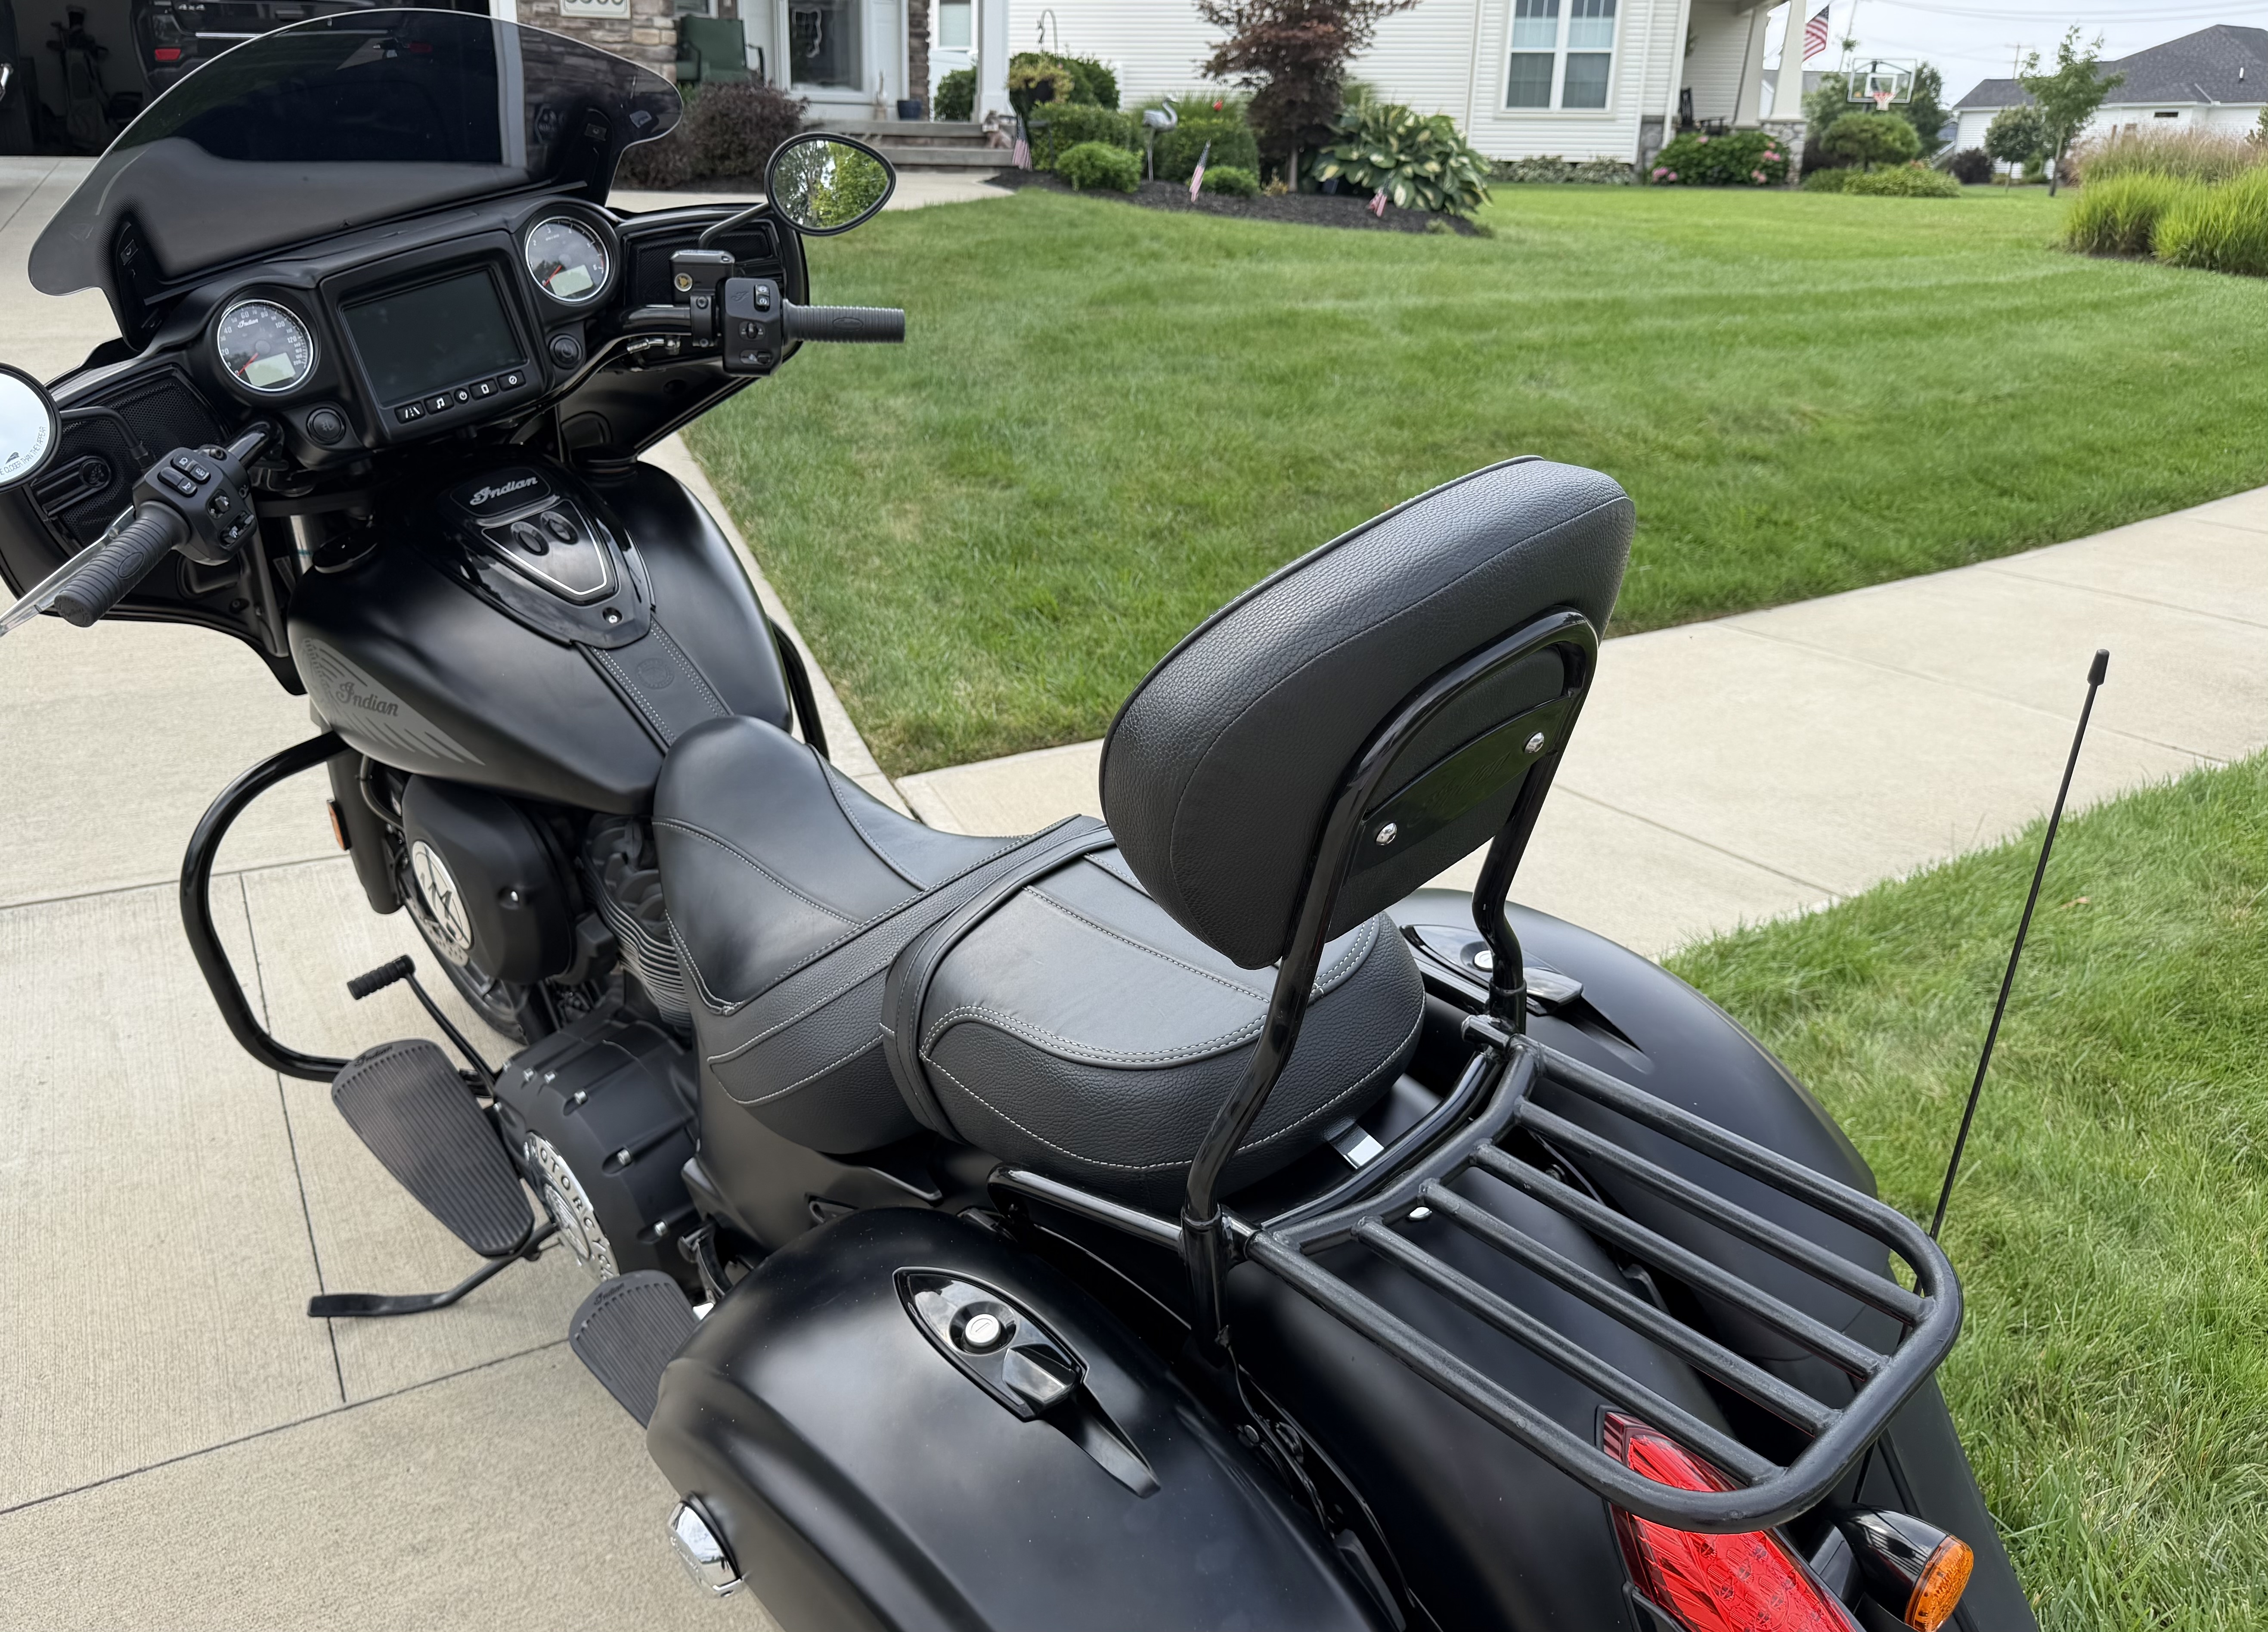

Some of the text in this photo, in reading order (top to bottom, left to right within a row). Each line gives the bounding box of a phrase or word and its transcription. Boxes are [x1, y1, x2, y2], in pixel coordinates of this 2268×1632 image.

[30, 443, 41, 458] THEY
[470, 477, 538, 506] Indian
[336, 681, 399, 717] Indian
